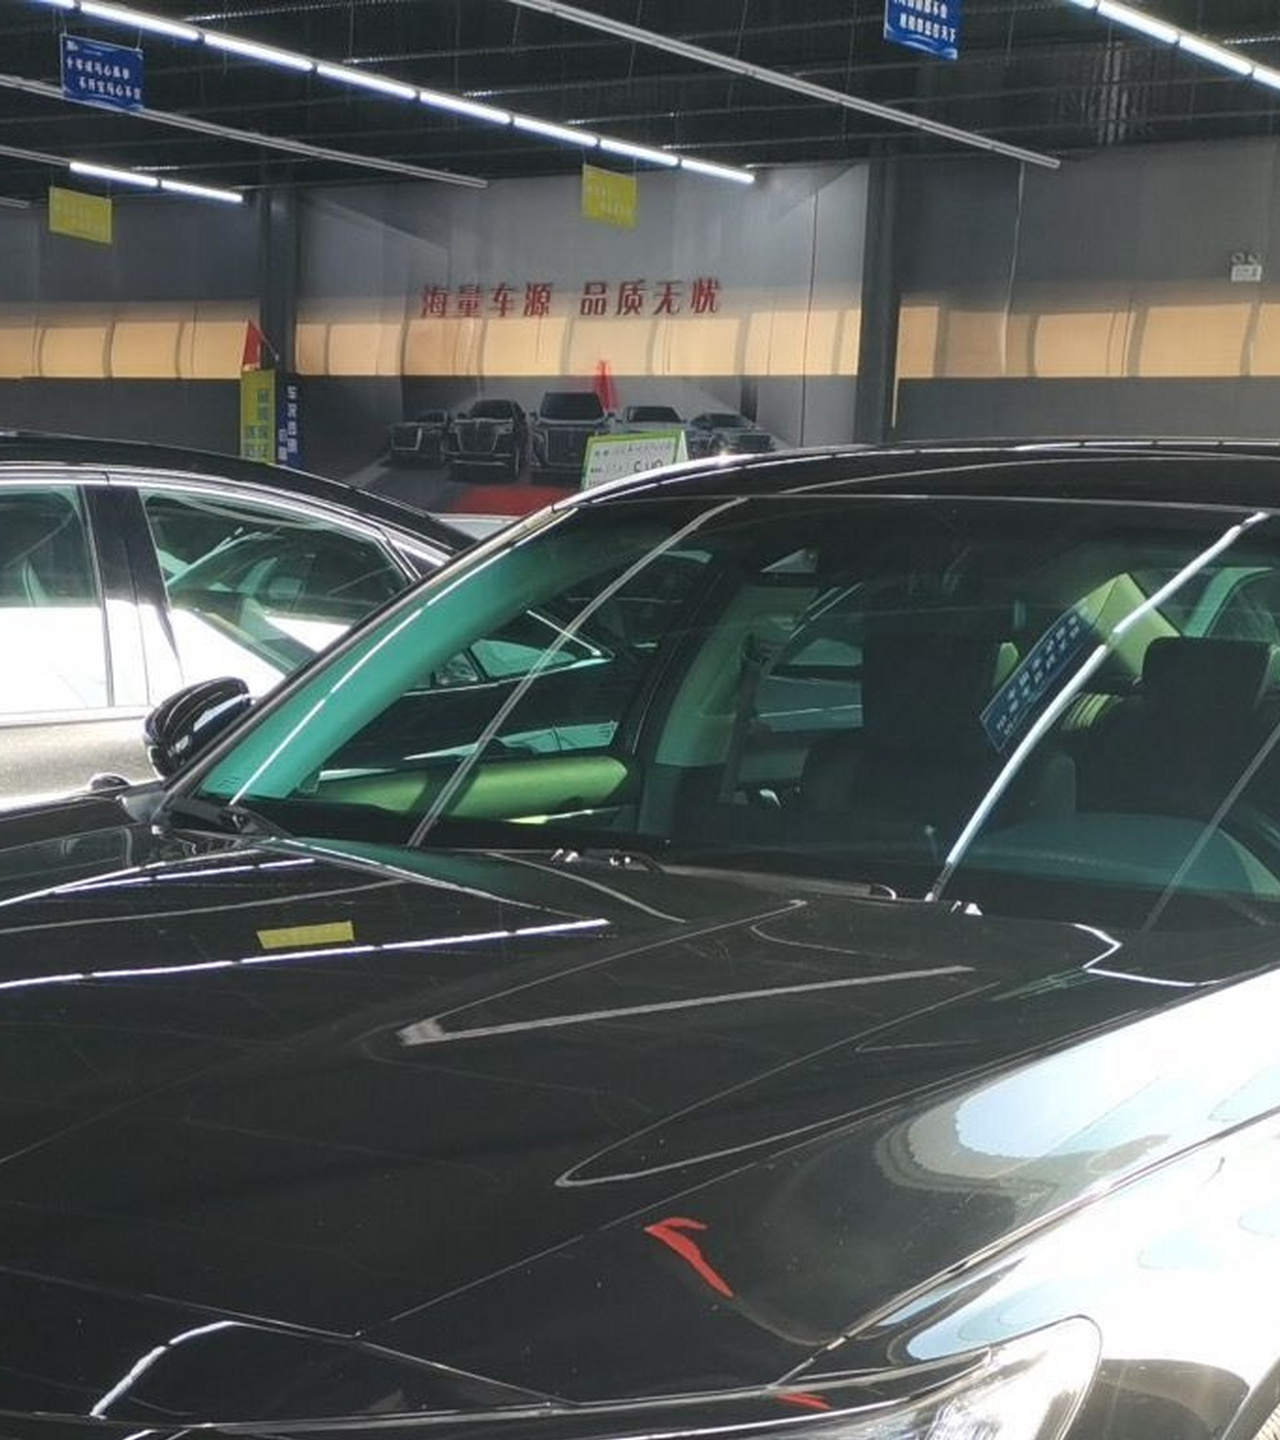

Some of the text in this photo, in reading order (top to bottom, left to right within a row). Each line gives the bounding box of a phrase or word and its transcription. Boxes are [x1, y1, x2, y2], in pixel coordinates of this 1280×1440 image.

[419, 276, 723, 319] 海量车源 品质无忧
